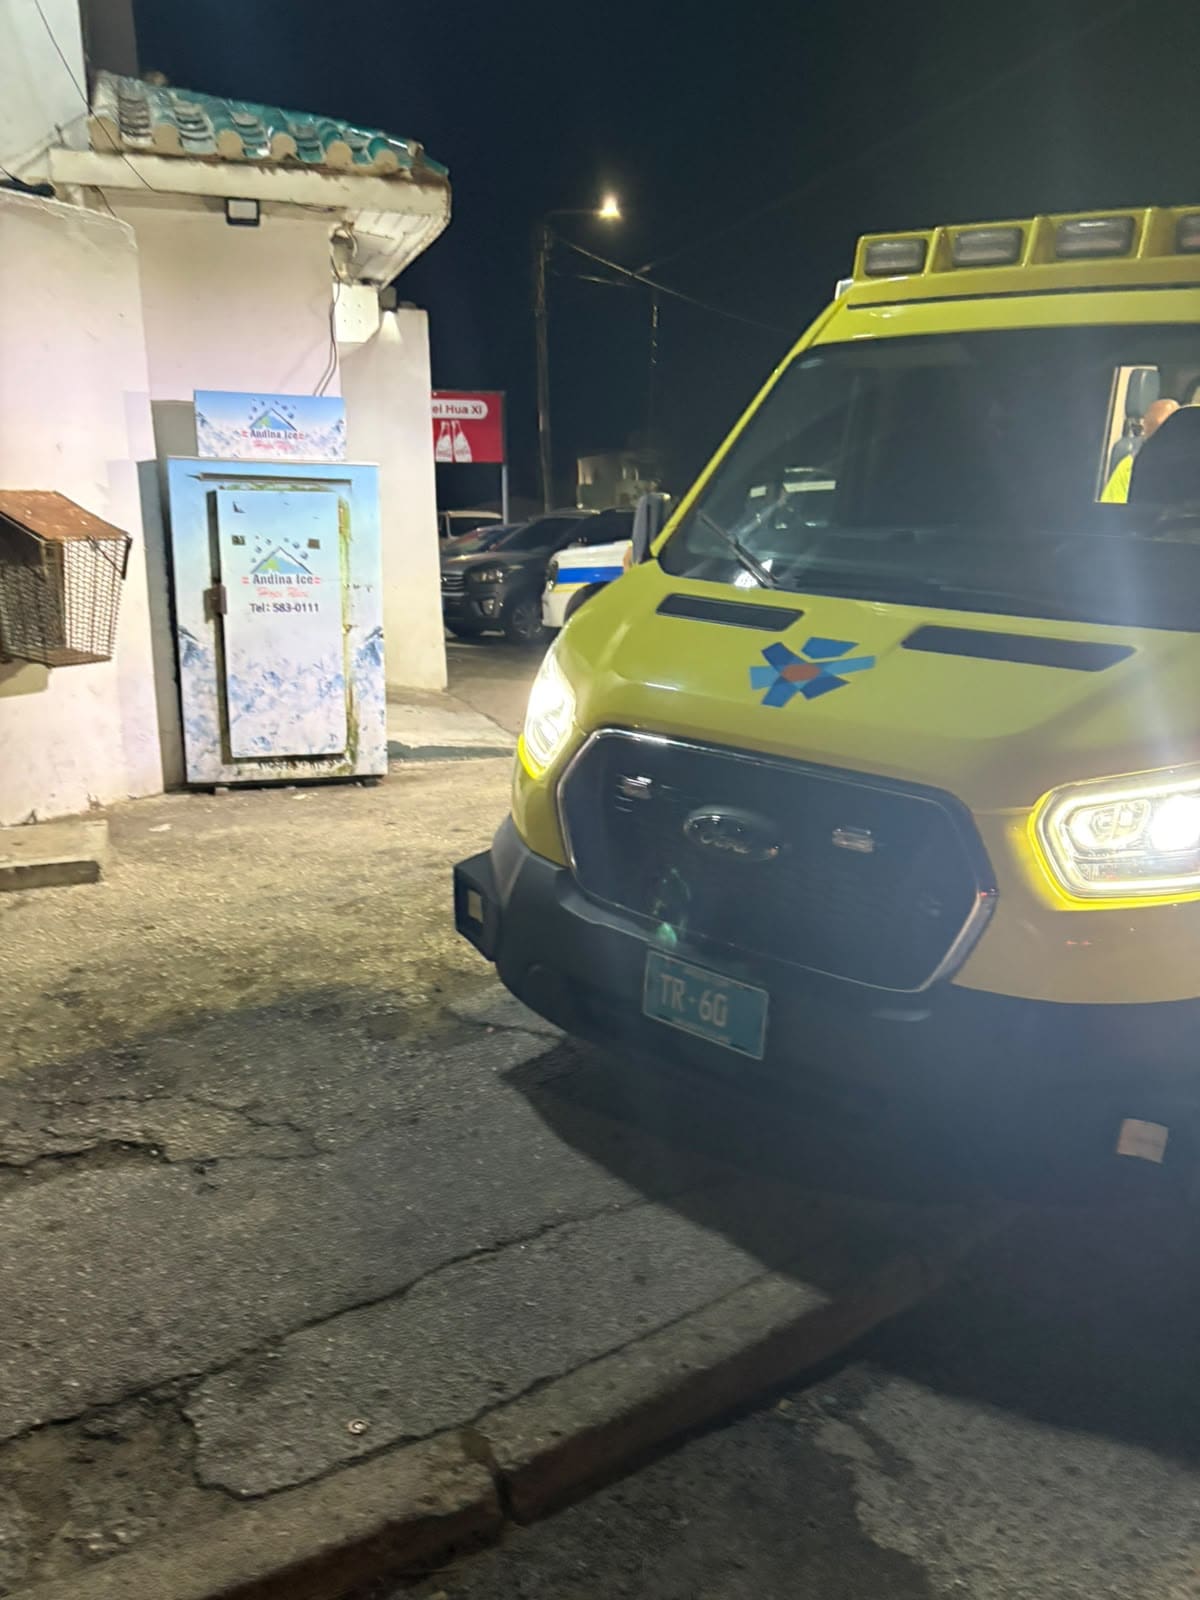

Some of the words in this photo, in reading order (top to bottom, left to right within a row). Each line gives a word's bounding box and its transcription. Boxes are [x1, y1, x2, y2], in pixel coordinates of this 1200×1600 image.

[446, 404, 469, 414] Hua
[471, 405, 482, 415] Xi
[250, 429, 281, 439] Andina
[284, 430, 297, 440] Ice
[253, 573, 292, 585] Andina
[296, 574, 313, 585] Ice
[249, 603, 270, 613] Tel:
[273, 603, 319, 613] 583-0111
